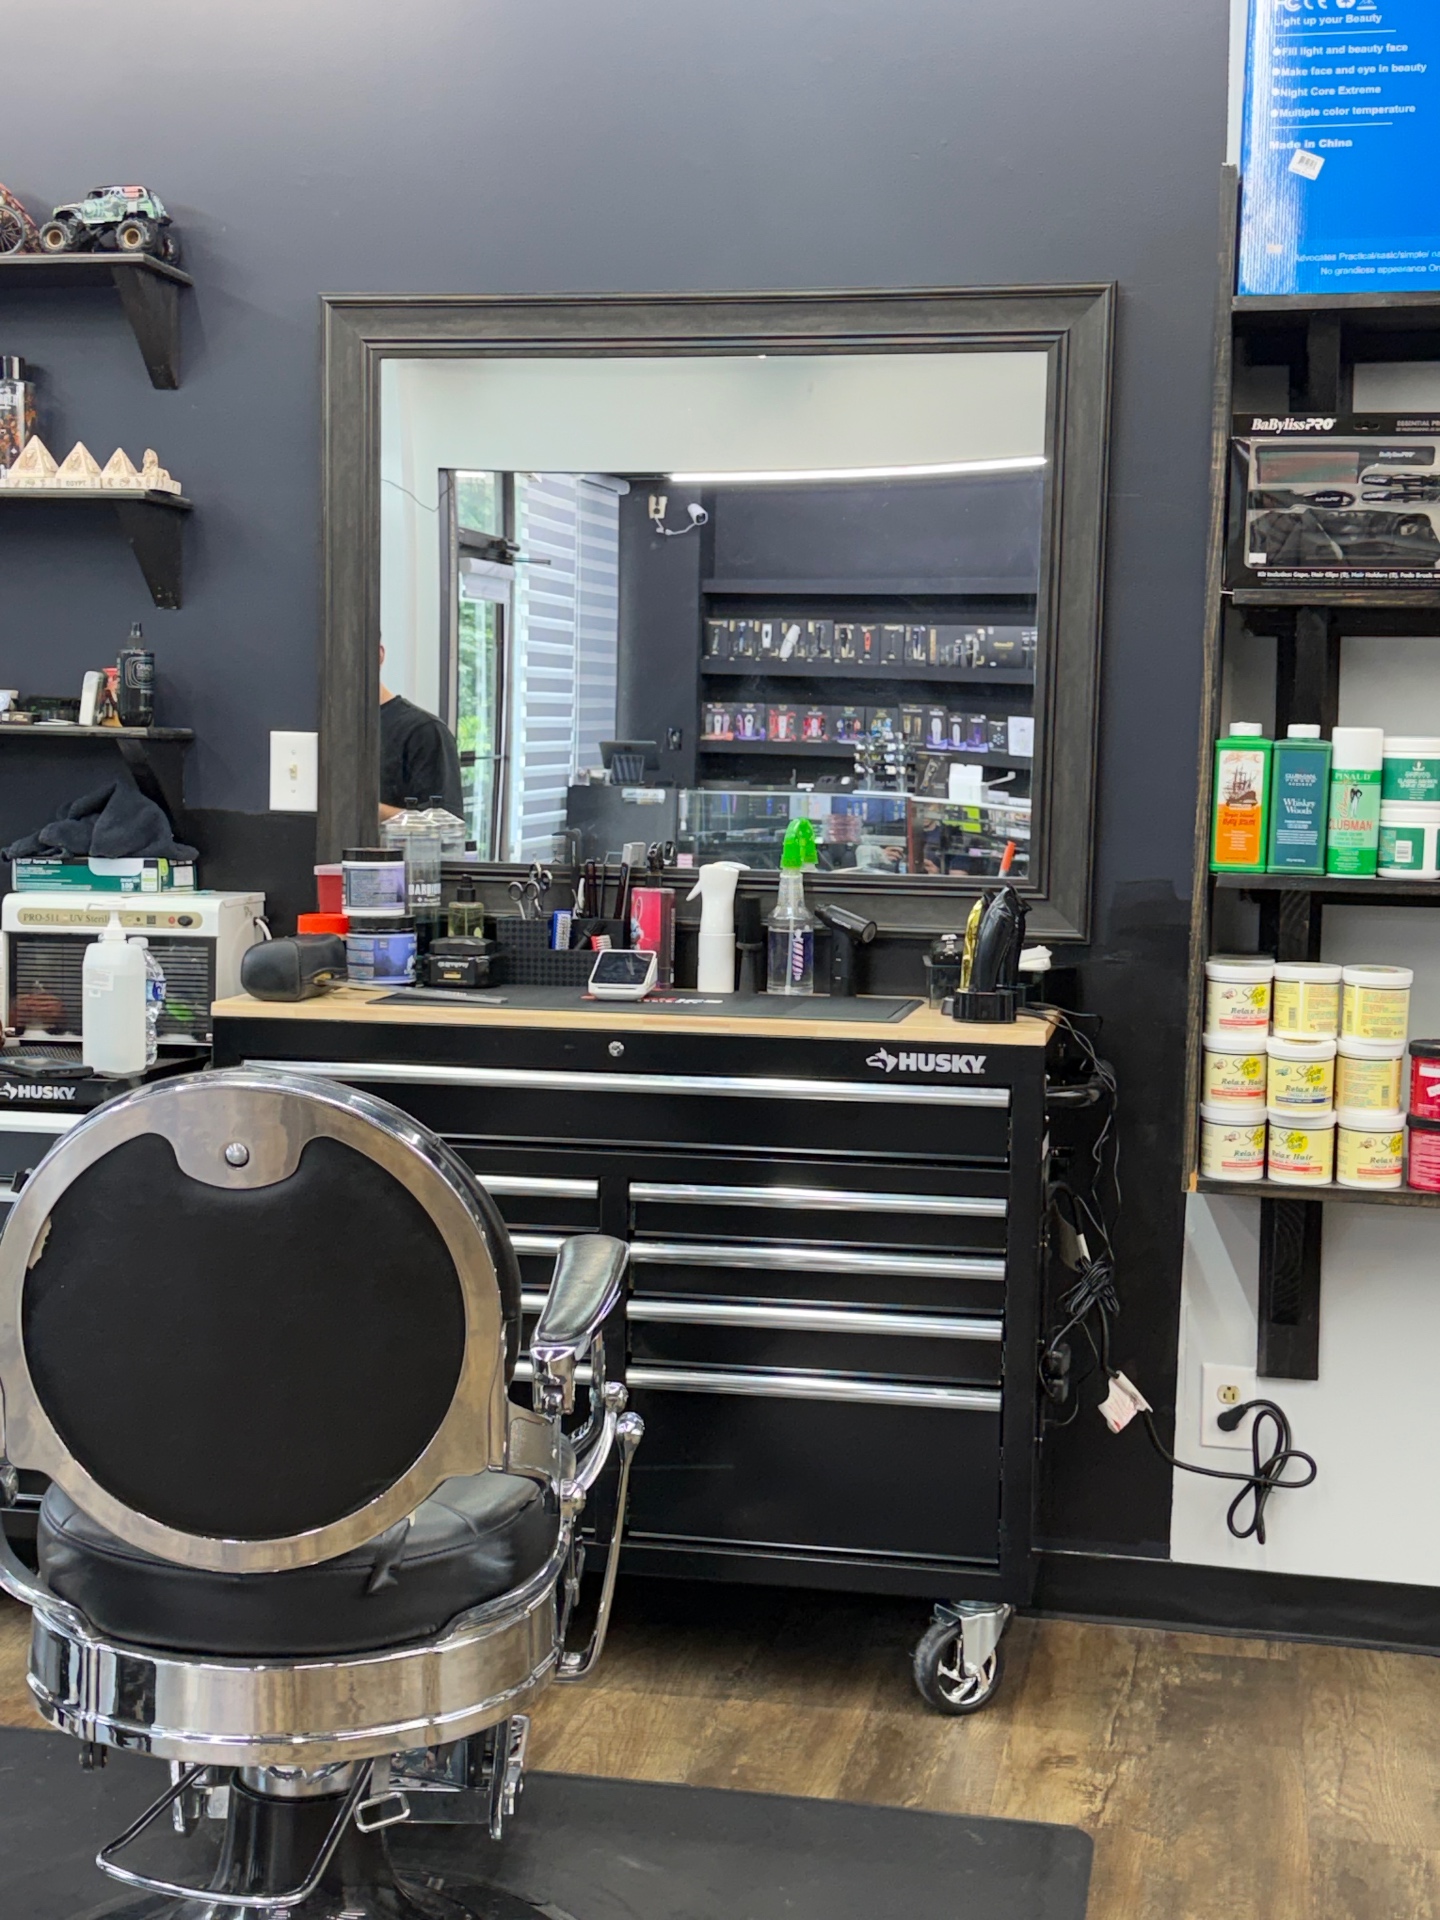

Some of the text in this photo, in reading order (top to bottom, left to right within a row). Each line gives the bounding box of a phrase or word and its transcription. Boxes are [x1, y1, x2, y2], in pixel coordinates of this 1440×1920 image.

[1275, 14, 1382, 27] Light up your Beauty
[1300, 46, 1323, 57] light
[1326, 45, 1345, 55] and
[1348, 45, 1383, 55] beauty
[1386, 43, 1408, 52] face
[1281, 63, 1427, 76] Make face and eye in beauty
[1280, 86, 1381, 98] Night Core Extreme
[1279, 105, 1416, 118] Multiple color temperature
[1270, 138, 1353, 150] Made in China
[1320, 267, 1333, 275] No
[1334, 265, 1376, 277] grandiose
[1377, 264, 1427, 275] appearance
[1329, 818, 1373, 831] CLUBMAN
[23, 913, 60, 922] PRO-511
[69, 914, 83, 923] UV
[898, 1051, 987, 1074] HUSKY
[1221, 1078, 1245, 1086] Relax
[1285, 1084, 1328, 1093] Relax Hair
[18, 1084, 76, 1100] HUSKY
